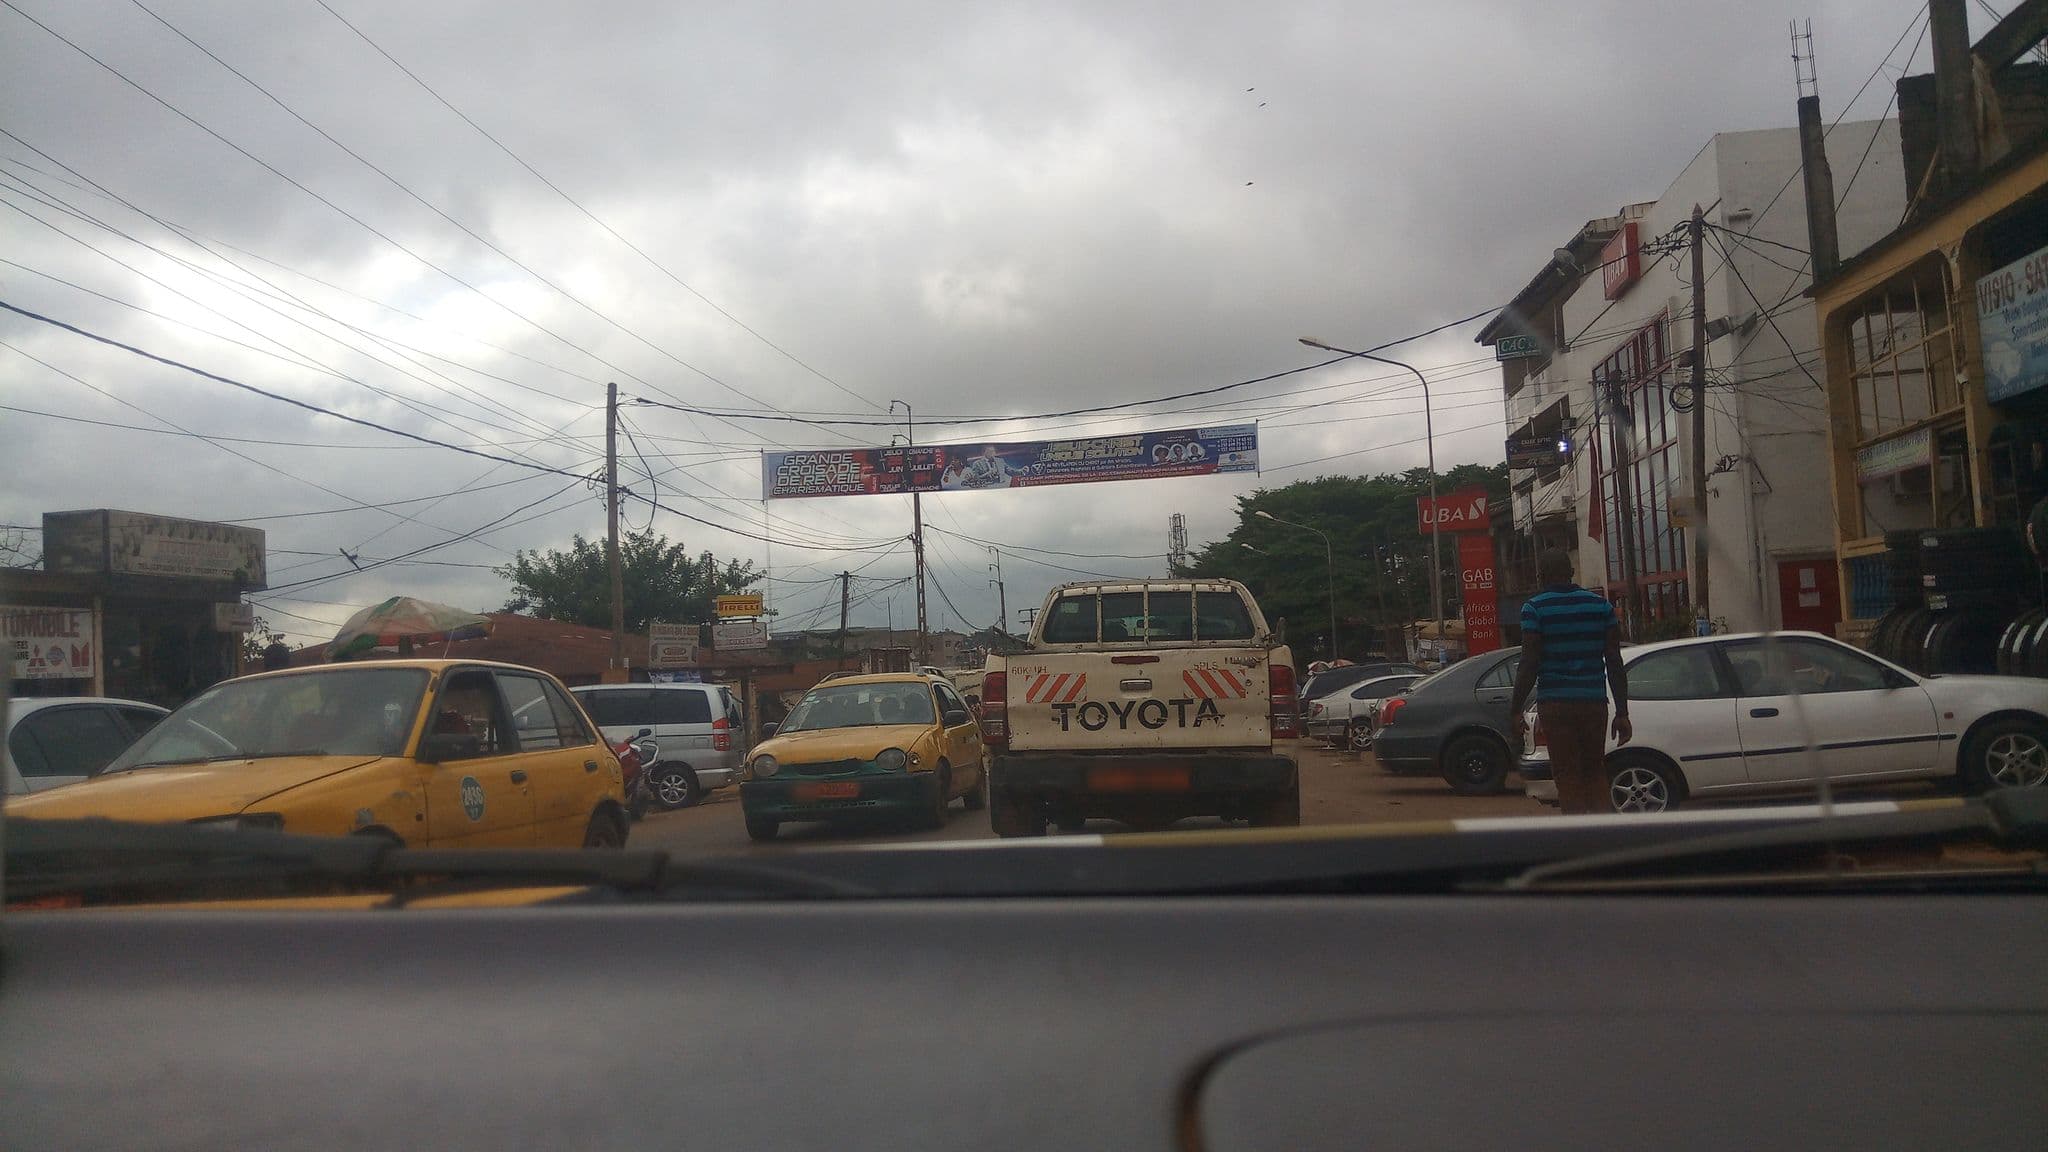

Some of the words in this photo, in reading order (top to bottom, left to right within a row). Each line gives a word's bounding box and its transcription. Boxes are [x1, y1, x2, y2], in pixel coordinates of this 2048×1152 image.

[1978, 271, 2015, 315] VISIO
[783, 453, 853, 466] GRANDE
[776, 463, 861, 476] CROISADE
[910, 463, 935, 471] JUILLET
[777, 475, 801, 486] DE
[773, 483, 865, 495] CHARISMATIQUE
[1422, 507, 1465, 524] UBA
[1462, 568, 1493, 583] GAB
[718, 600, 760, 611] PIRELLI
[1467, 615, 1496, 627] Global
[1472, 628, 1495, 640] Bank
[1051, 698, 1225, 732] TOYOTA
